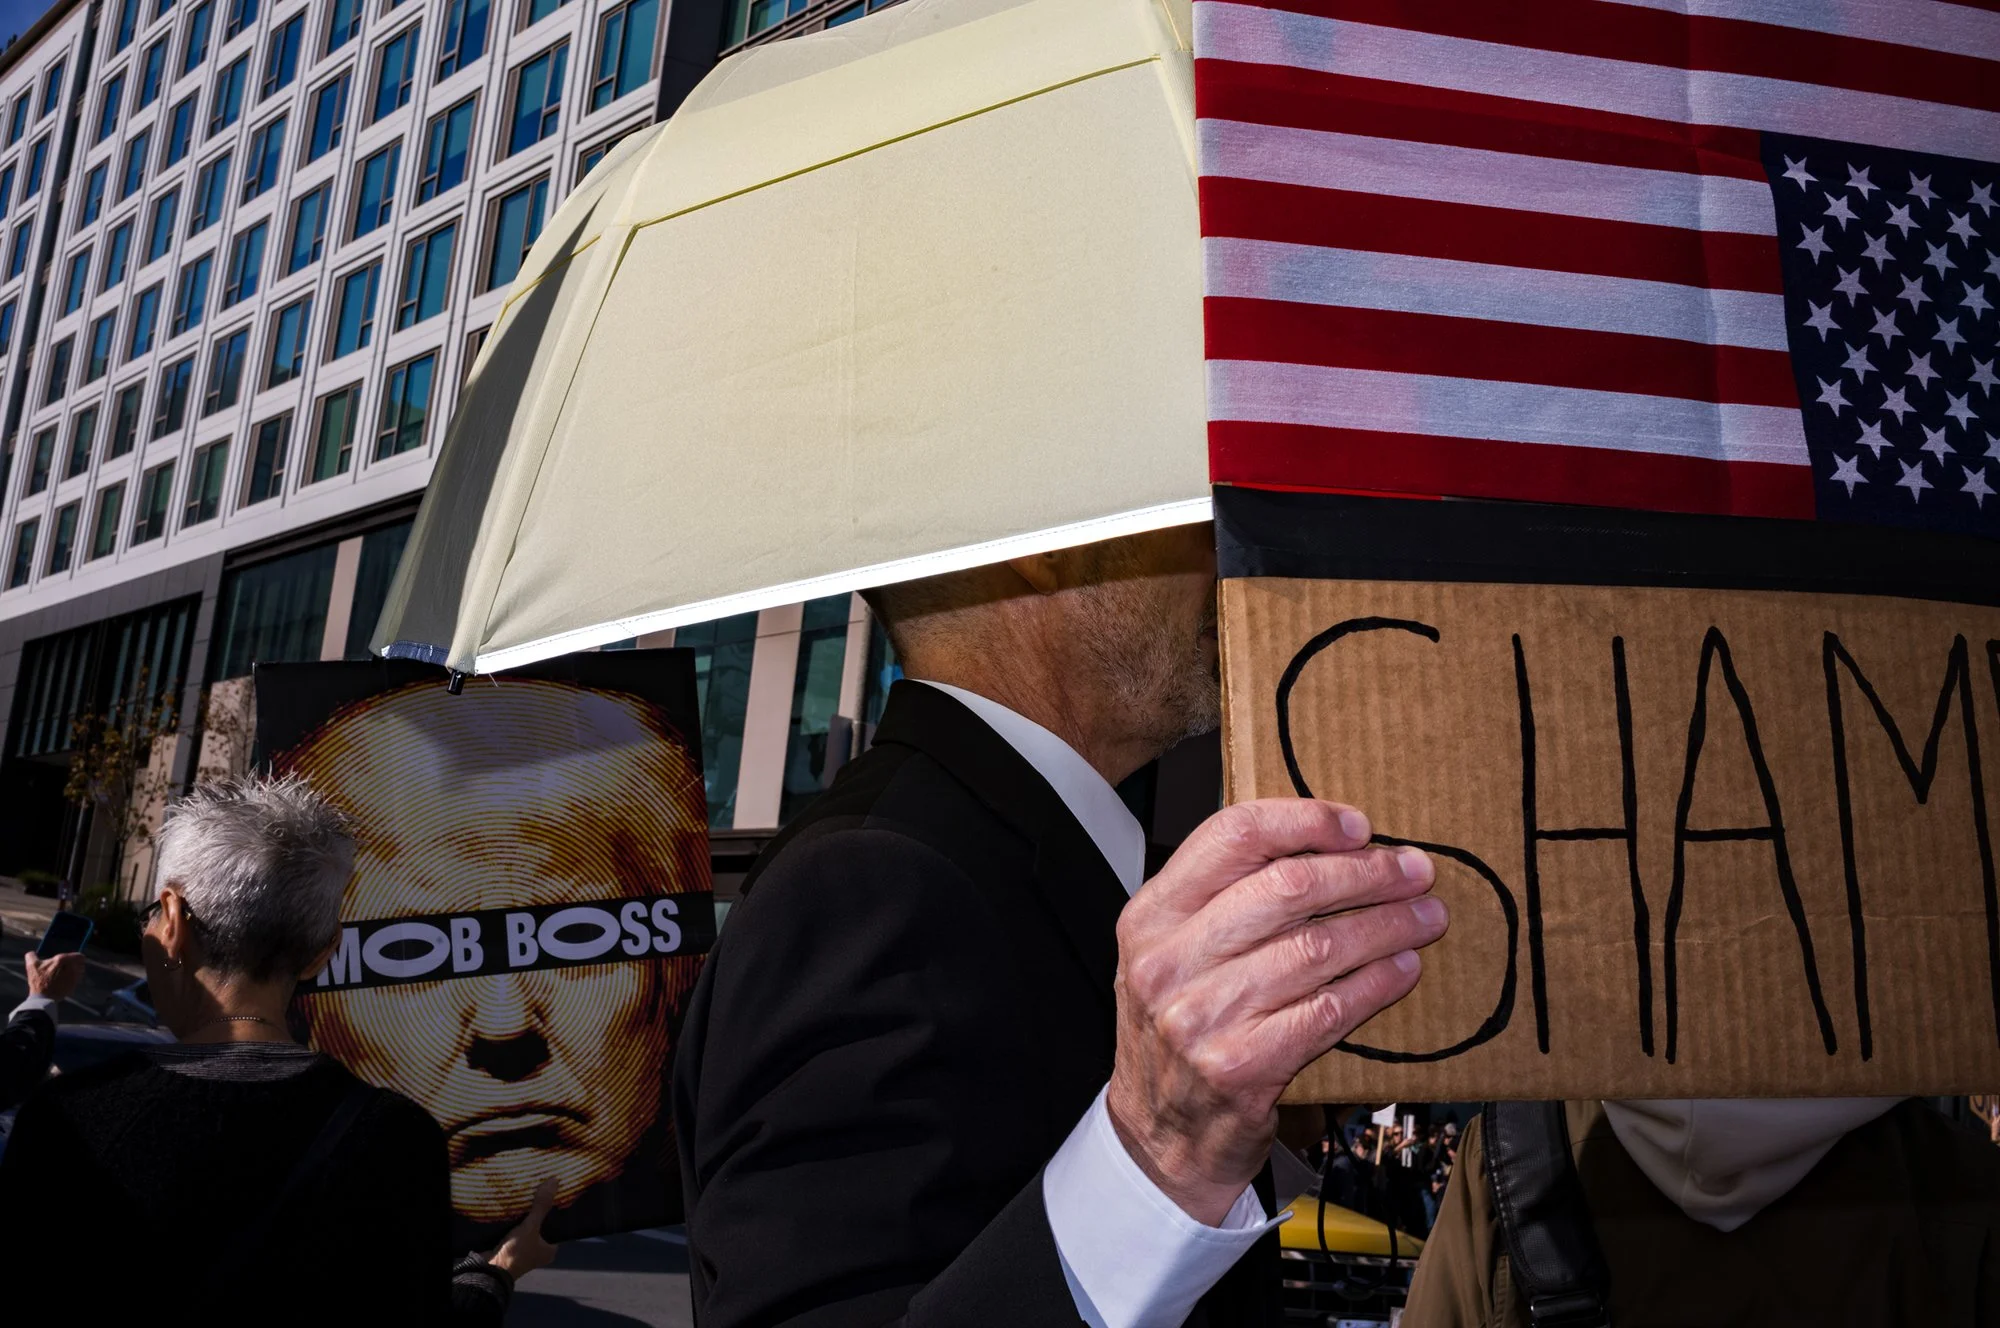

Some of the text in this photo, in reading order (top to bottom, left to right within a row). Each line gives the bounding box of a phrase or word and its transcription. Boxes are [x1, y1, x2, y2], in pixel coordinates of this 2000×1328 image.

[317, 899, 682, 987] MOB BOSS
[1276, 616, 2000, 1063] SHAM
